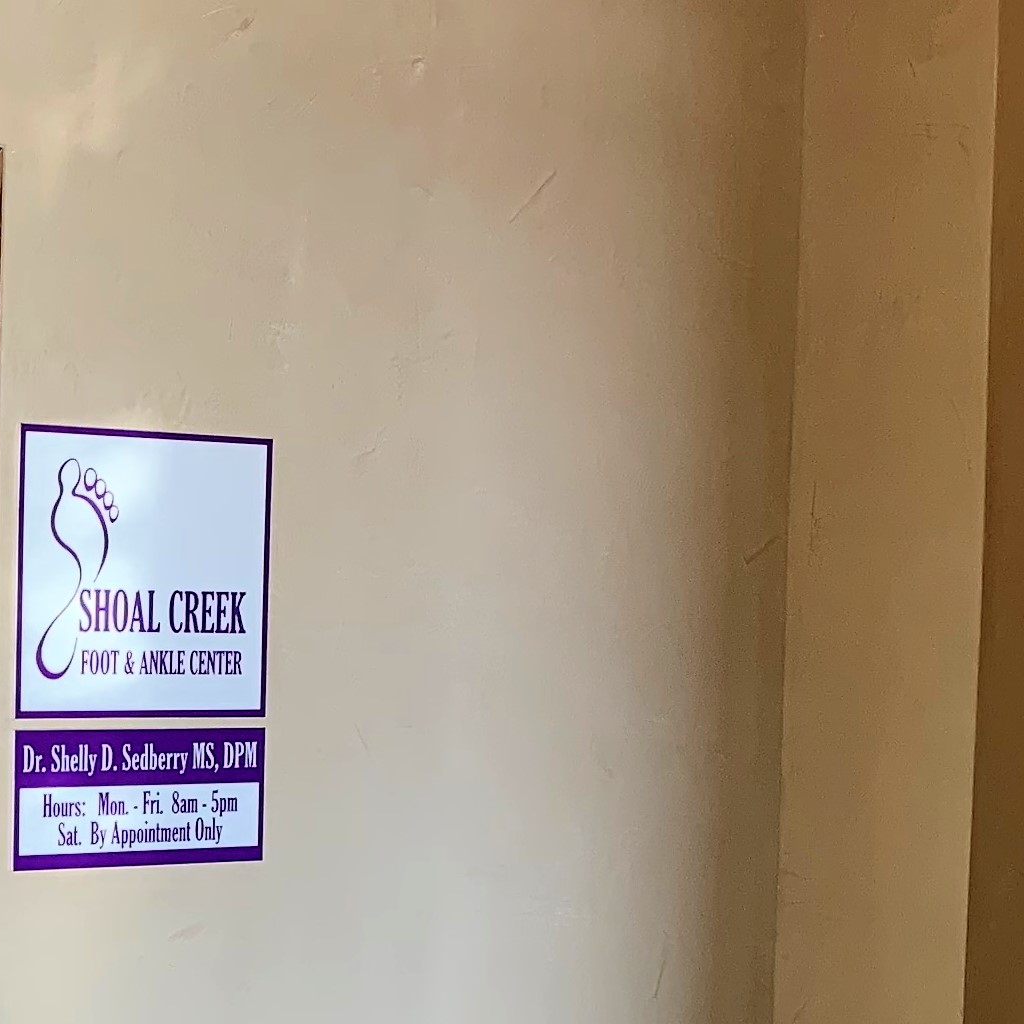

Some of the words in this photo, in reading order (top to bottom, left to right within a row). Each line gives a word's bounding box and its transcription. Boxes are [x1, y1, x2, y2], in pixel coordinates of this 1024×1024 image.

[79, 589, 161, 632] SHOAL
[168, 590, 247, 634] CREEK
[80, 650, 120, 675] FOOT
[124, 650, 134, 675] &
[139, 650, 186, 675] ANKLE
[189, 650, 243, 675] CENTER
[23, 744, 47, 773] Dr.
[50, 743, 98, 776] Shelly
[101, 743, 118, 772] D.
[122, 742, 189, 775] Sedberry
[192, 741, 220, 773] MS,
[223, 741, 258, 769] DPM
[42, 793, 86, 818] Hours:
[97, 791, 129, 816] Mon.
[142, 790, 164, 815] Fri.
[171, 790, 198, 813] 8am
[211, 789, 238, 817] 5pm
[57, 822, 82, 847] Sat.
[90, 820, 107, 849] By
[111, 820, 191, 848] Appointment
[195, 817, 223, 845] Only
